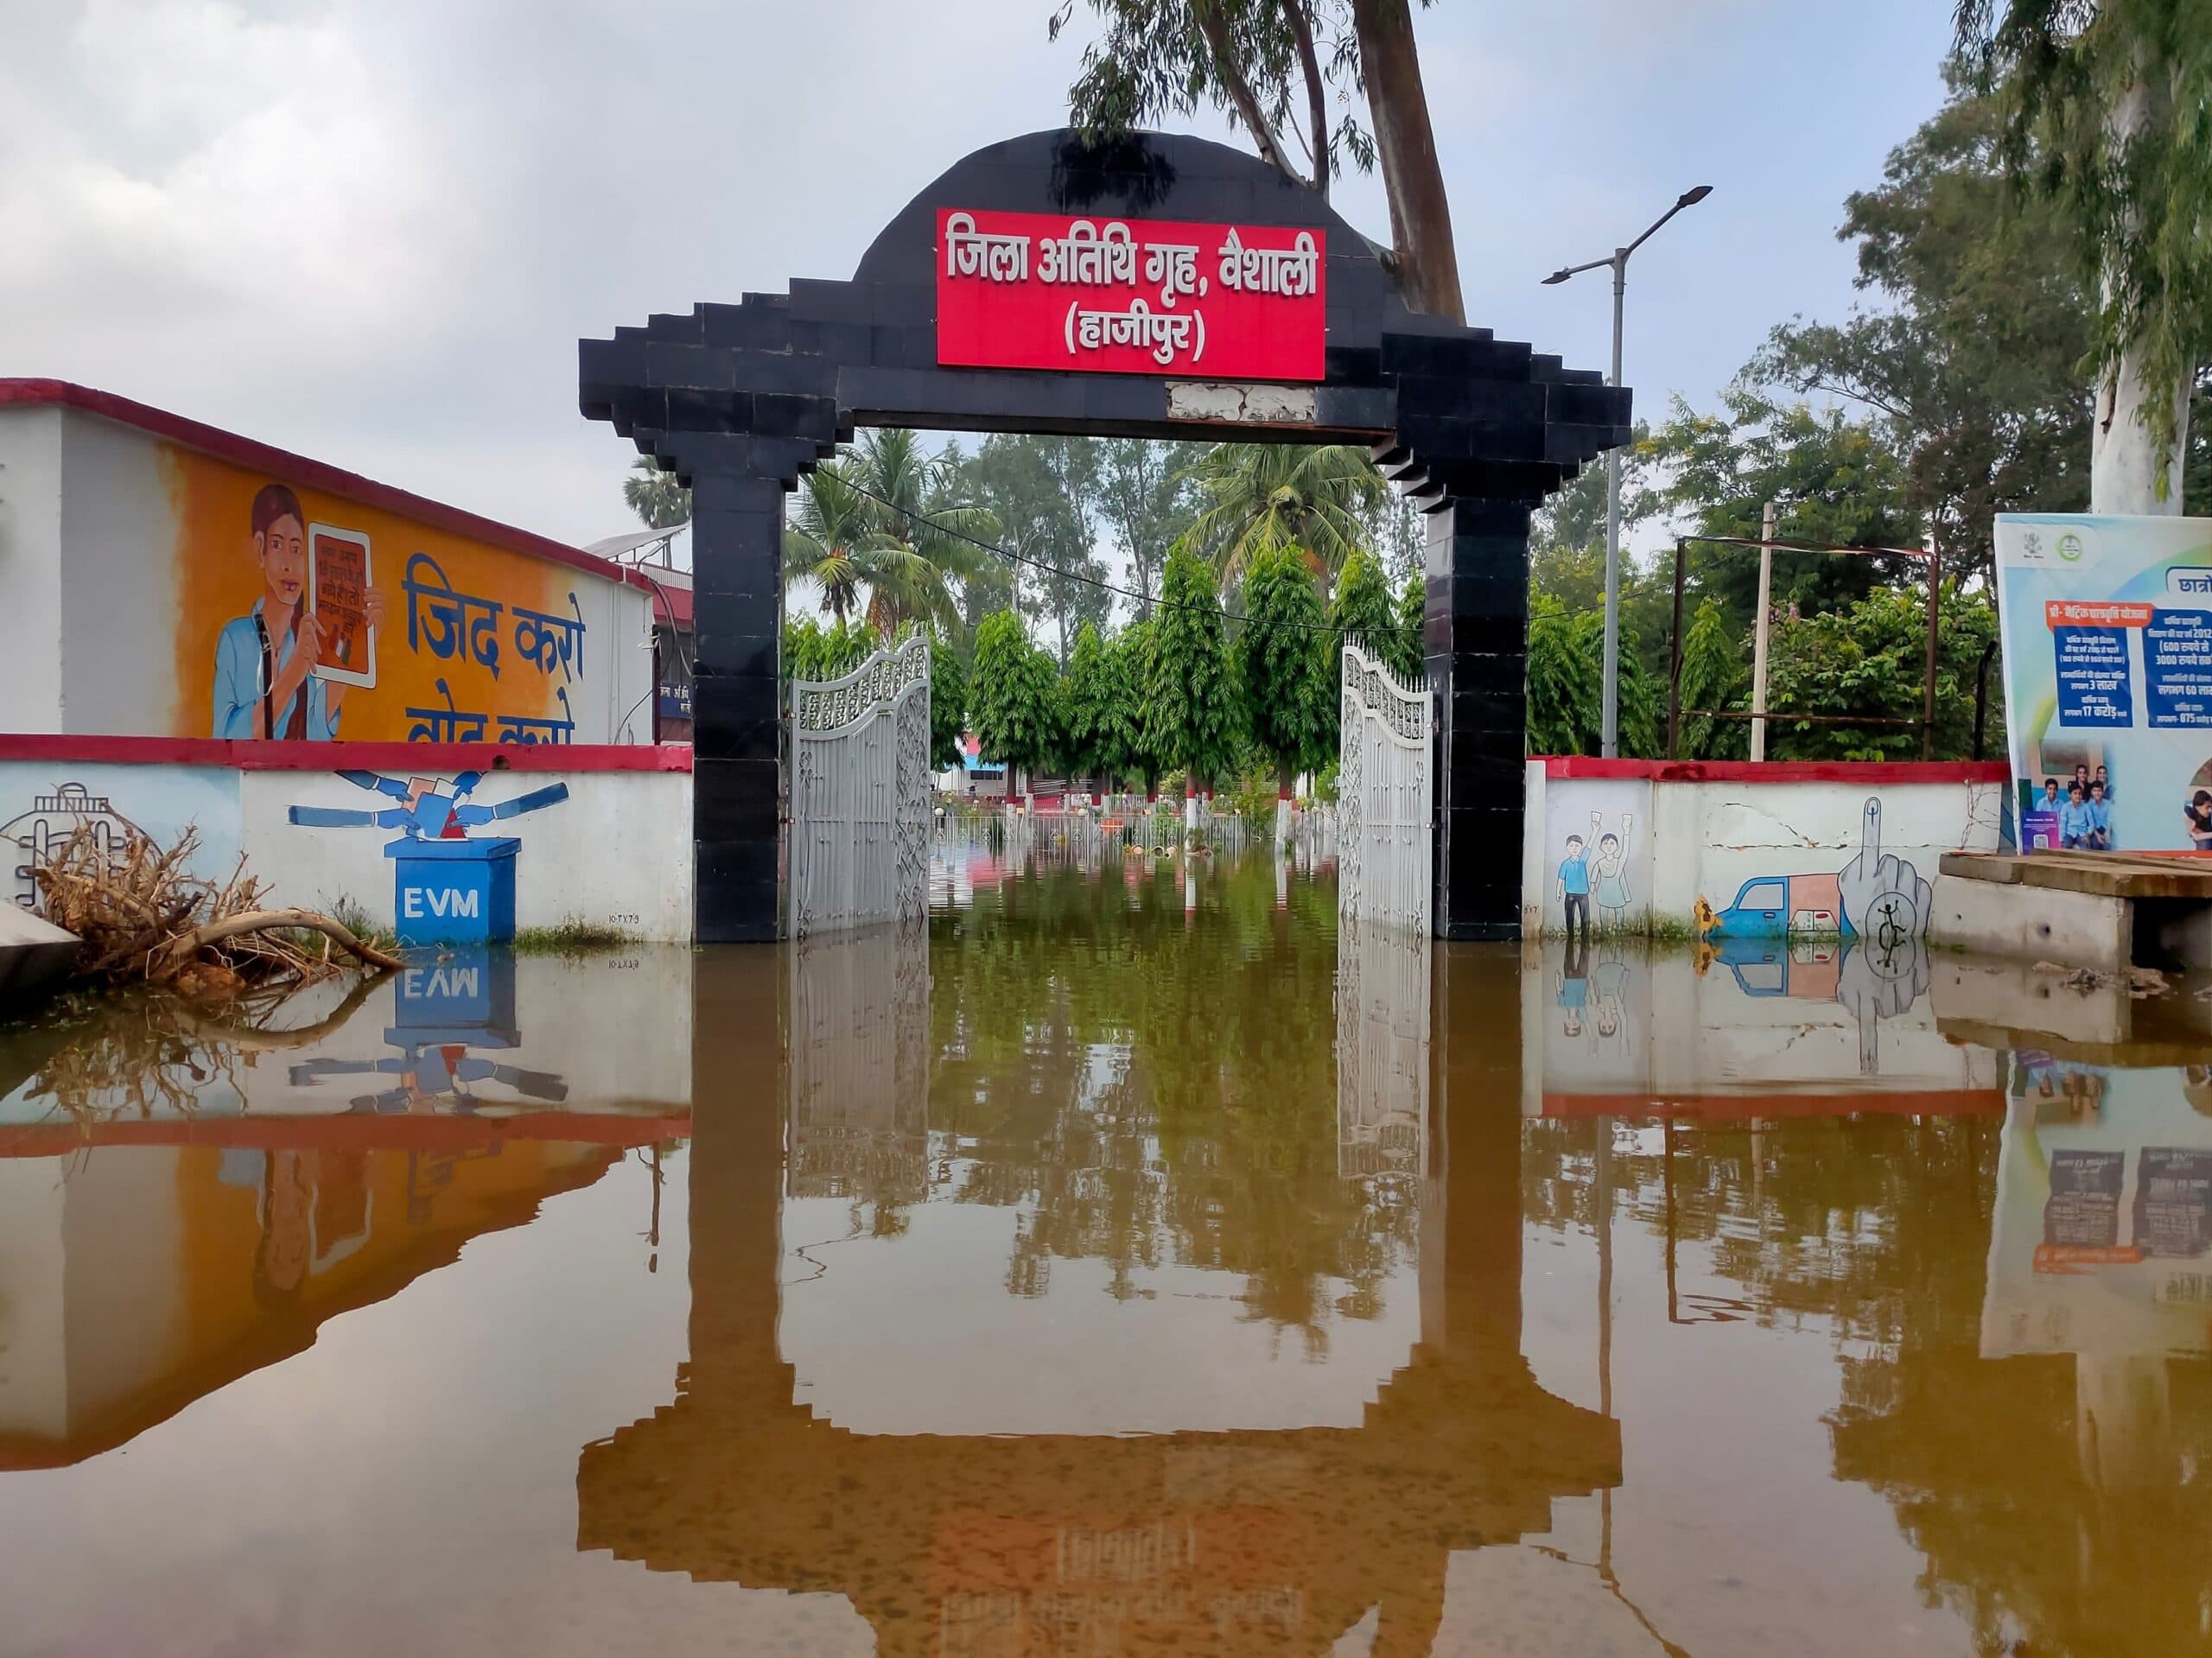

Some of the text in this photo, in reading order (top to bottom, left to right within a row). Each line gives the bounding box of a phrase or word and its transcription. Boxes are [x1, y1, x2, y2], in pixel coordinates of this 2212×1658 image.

[945, 212, 1319, 308] जिला अतिथि गृह, वैशाली
[1065, 298, 1205, 365] (हाजीपुर)
[401, 552, 587, 683] जिद करो
[2089, 680, 2095, 690] 3
[2096, 680, 2118, 690] लाख
[2082, 706, 2092, 717] 17
[404, 887, 478, 918] EVM
